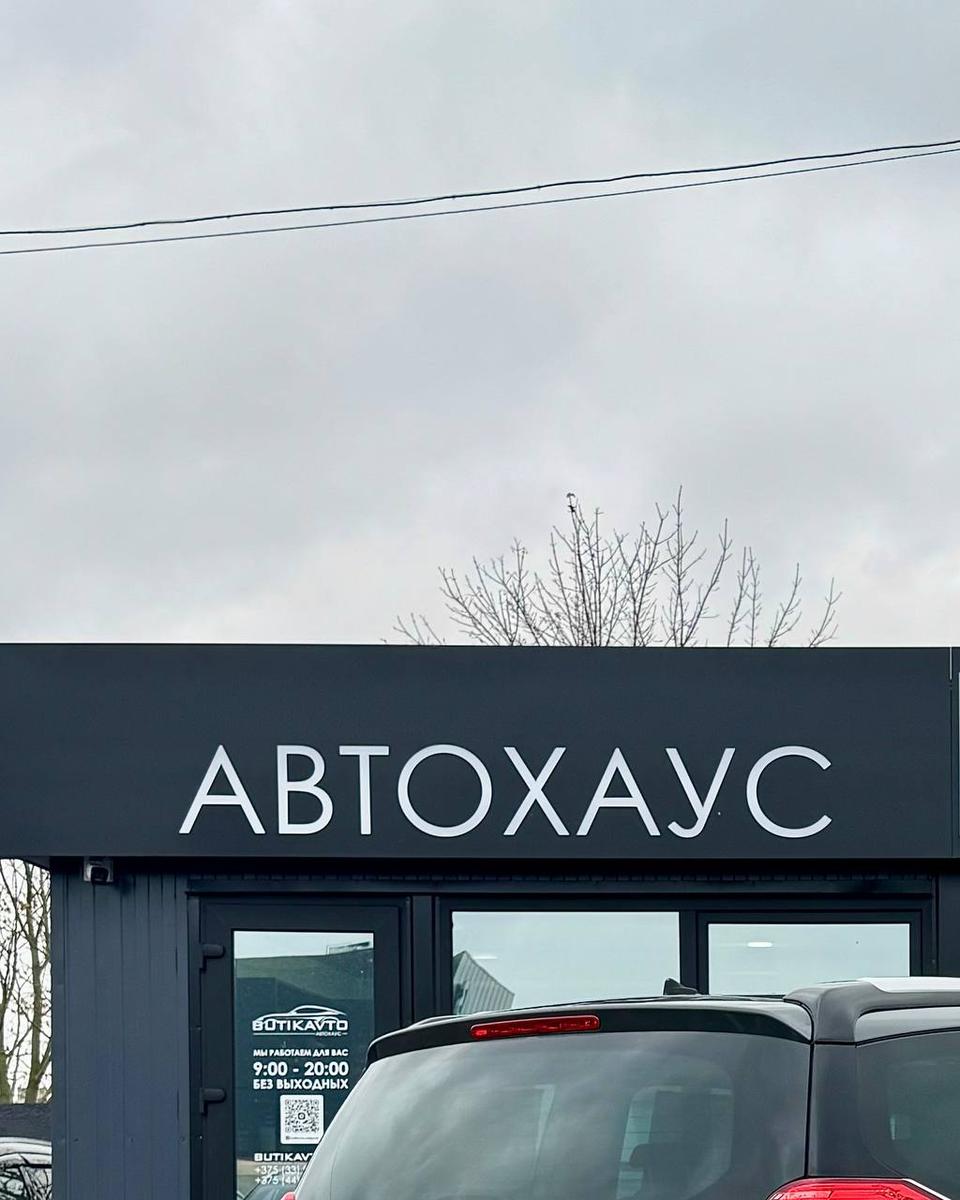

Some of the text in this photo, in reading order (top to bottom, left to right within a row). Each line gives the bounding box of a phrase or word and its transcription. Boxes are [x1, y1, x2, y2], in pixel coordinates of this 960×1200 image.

[178, 743, 833, 840] АВТОХАУС
[252, 1019, 348, 1031] BUTIKAVTO
[253, 1049, 349, 1057] МЫ РАБОТАЕМ ДЛЯ ВАС
[253, 1062, 288, 1076] 9:00
[304, 1061, 349, 1076] 20:00
[253, 1079, 349, 1090] БЕЗ ВЫХОДНЫХ
[254, 1153, 313, 1162] BUTIKAV
[254, 1165, 279, 1175] +375
